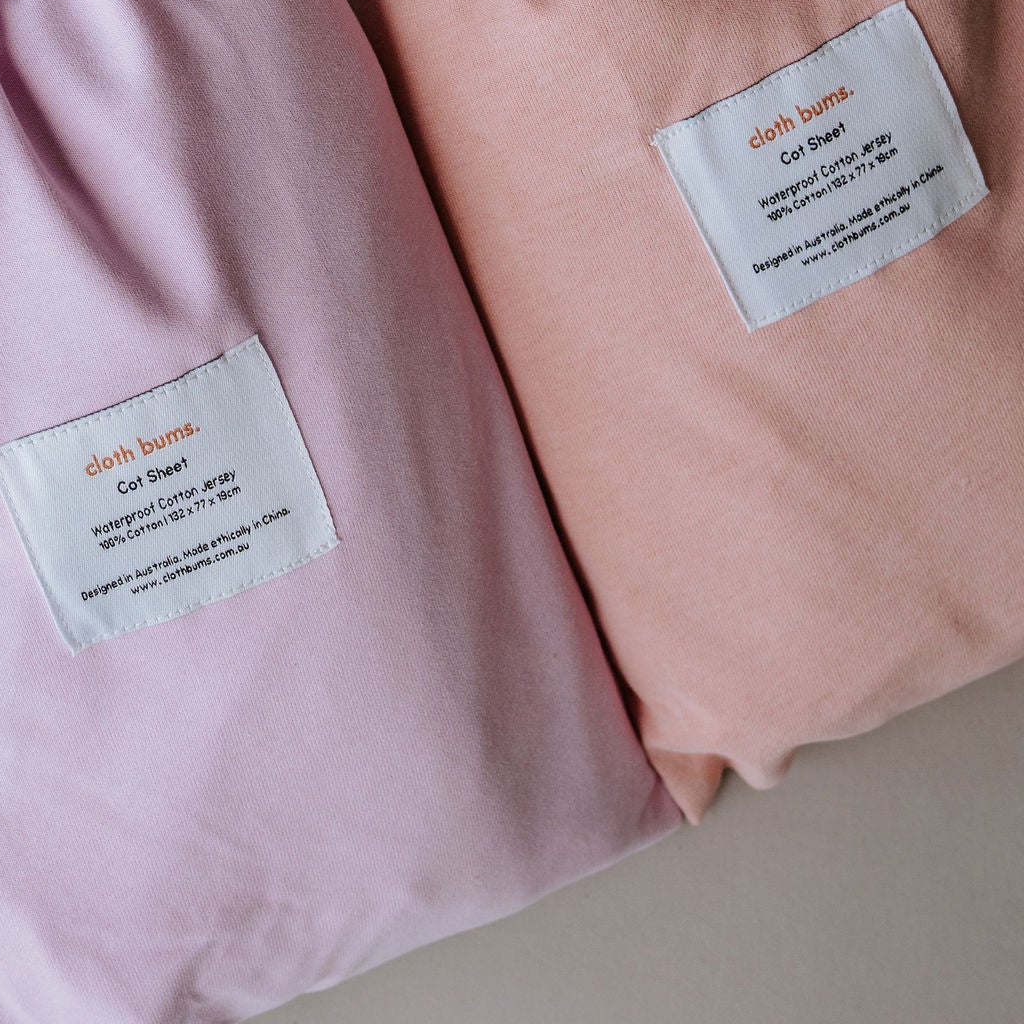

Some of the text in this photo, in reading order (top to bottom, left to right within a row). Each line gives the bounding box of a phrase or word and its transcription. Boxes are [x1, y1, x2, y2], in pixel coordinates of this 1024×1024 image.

[748, 86, 854, 149] cloth bums.
[780, 121, 846, 165] Cot Sheet
[757, 131, 892, 209] Waterproof Cotton Jersey
[766, 205, 793, 222] 100%
[792, 187, 828, 210] Cotton
[830, 174, 848, 189] 132
[848, 171, 856, 182] x
[854, 162, 866, 177] 77
[867, 160, 876, 170] x
[874, 147, 898, 164] 19cm
[752, 164, 944, 274] Designed in Australia. Made ethically in China.
[85, 422, 200, 476] cloth bums.
[116, 456, 188, 495] Cot Sheet
[90, 469, 235, 537] Waterproof Cotton Jersey
[98, 534, 126, 550] 100%
[126, 519, 164, 540] Cotton
[167, 507, 186, 522] 132
[186, 506, 194, 516] x
[193, 498, 206, 512] 77
[207, 497, 216, 507] x
[215, 485, 241, 502] 19cm
[80, 507, 291, 601] Designed in Australia. Made ethically in China.
